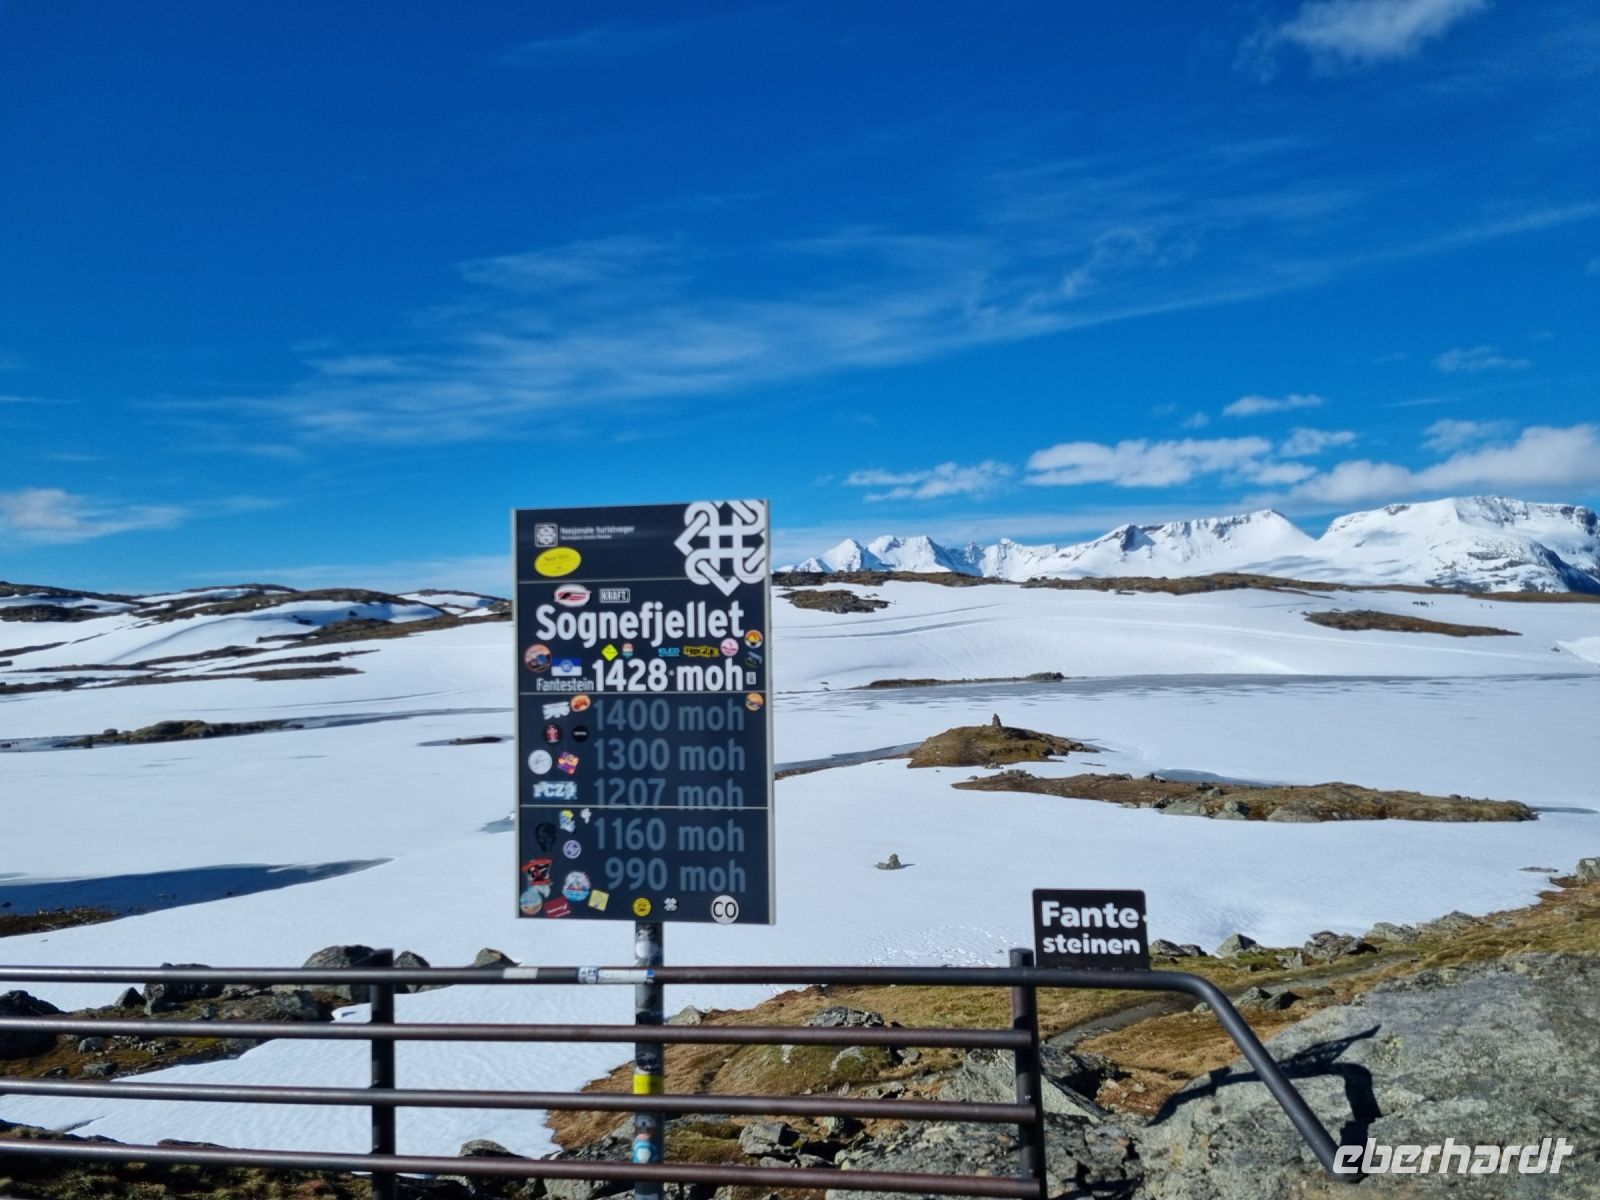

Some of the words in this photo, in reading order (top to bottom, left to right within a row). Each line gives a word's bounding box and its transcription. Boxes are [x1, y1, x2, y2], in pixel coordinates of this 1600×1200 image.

[536, 601, 744, 648] Sognefjellet
[536, 677, 594, 692] Fantestein
[592, 658, 668, 692] 1428
[676, 657, 743, 691] moh
[593, 698, 670, 731] 1400
[678, 697, 744, 731] moh
[593, 738, 670, 771] 1300
[679, 737, 745, 771] moh
[594, 778, 666, 810] 1207
[678, 778, 744, 810] moh
[594, 817, 666, 851] 1160
[678, 818, 744, 852] moh
[605, 856, 668, 891] 990
[680, 858, 746, 893] moh
[712, 901, 737, 919] CO
[1042, 932, 1141, 955] steinen
